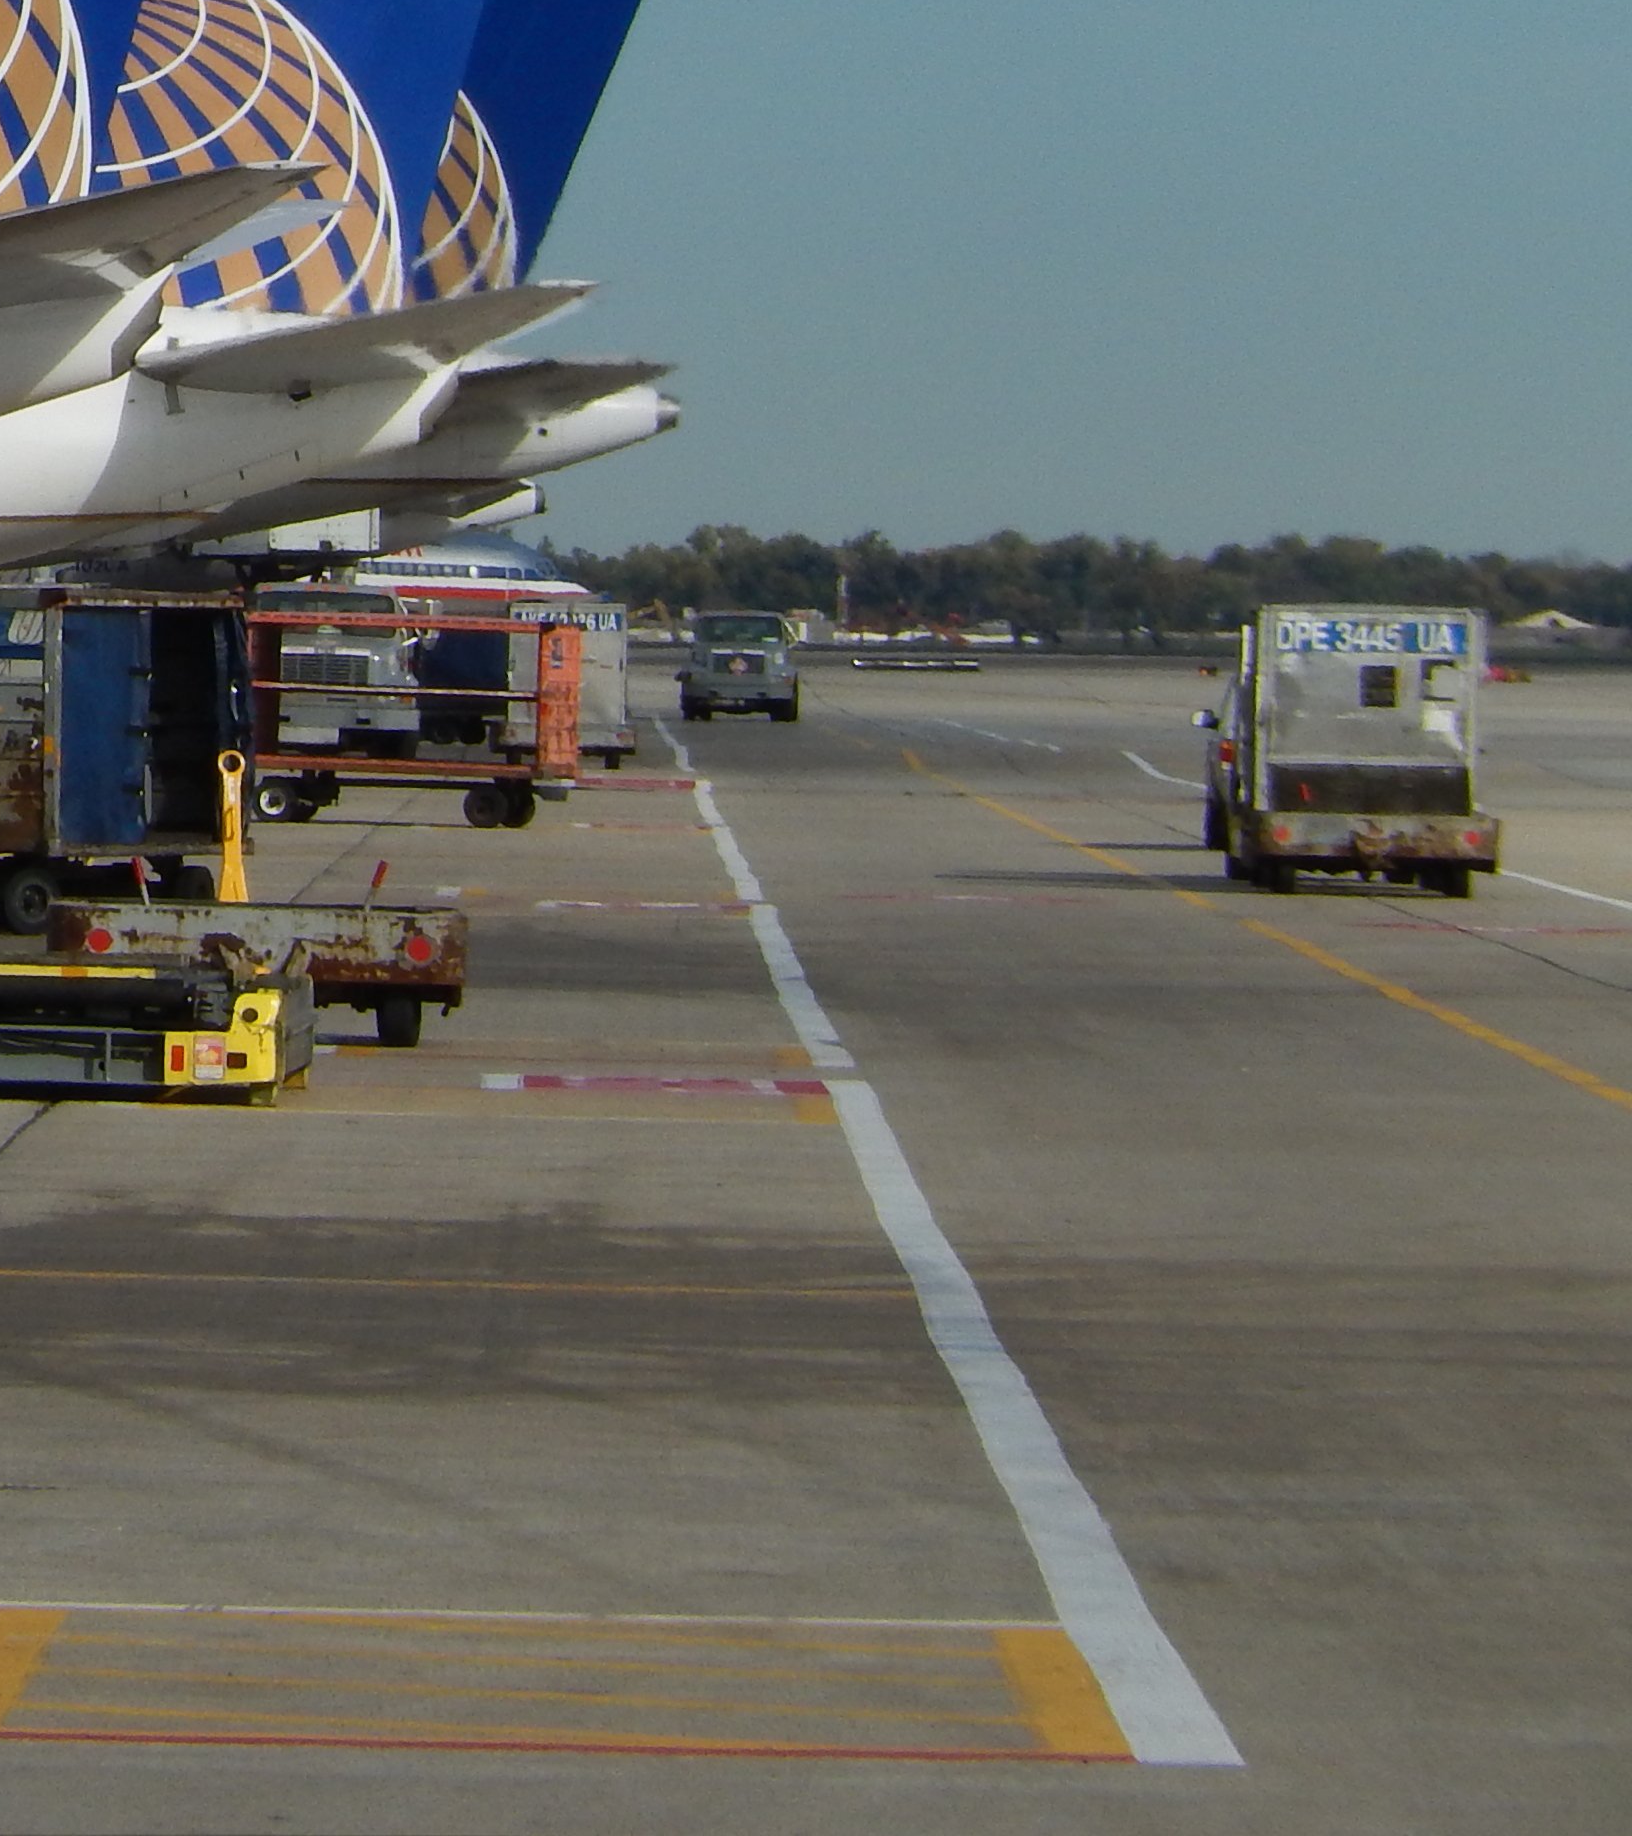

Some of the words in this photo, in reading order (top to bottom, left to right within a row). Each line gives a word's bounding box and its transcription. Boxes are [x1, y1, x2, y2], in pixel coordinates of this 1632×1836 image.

[598, 612, 618, 631] UA
[1276, 621, 1329, 651] DPE
[1334, 622, 1405, 652] 3445
[1417, 623, 1455, 653] UA
